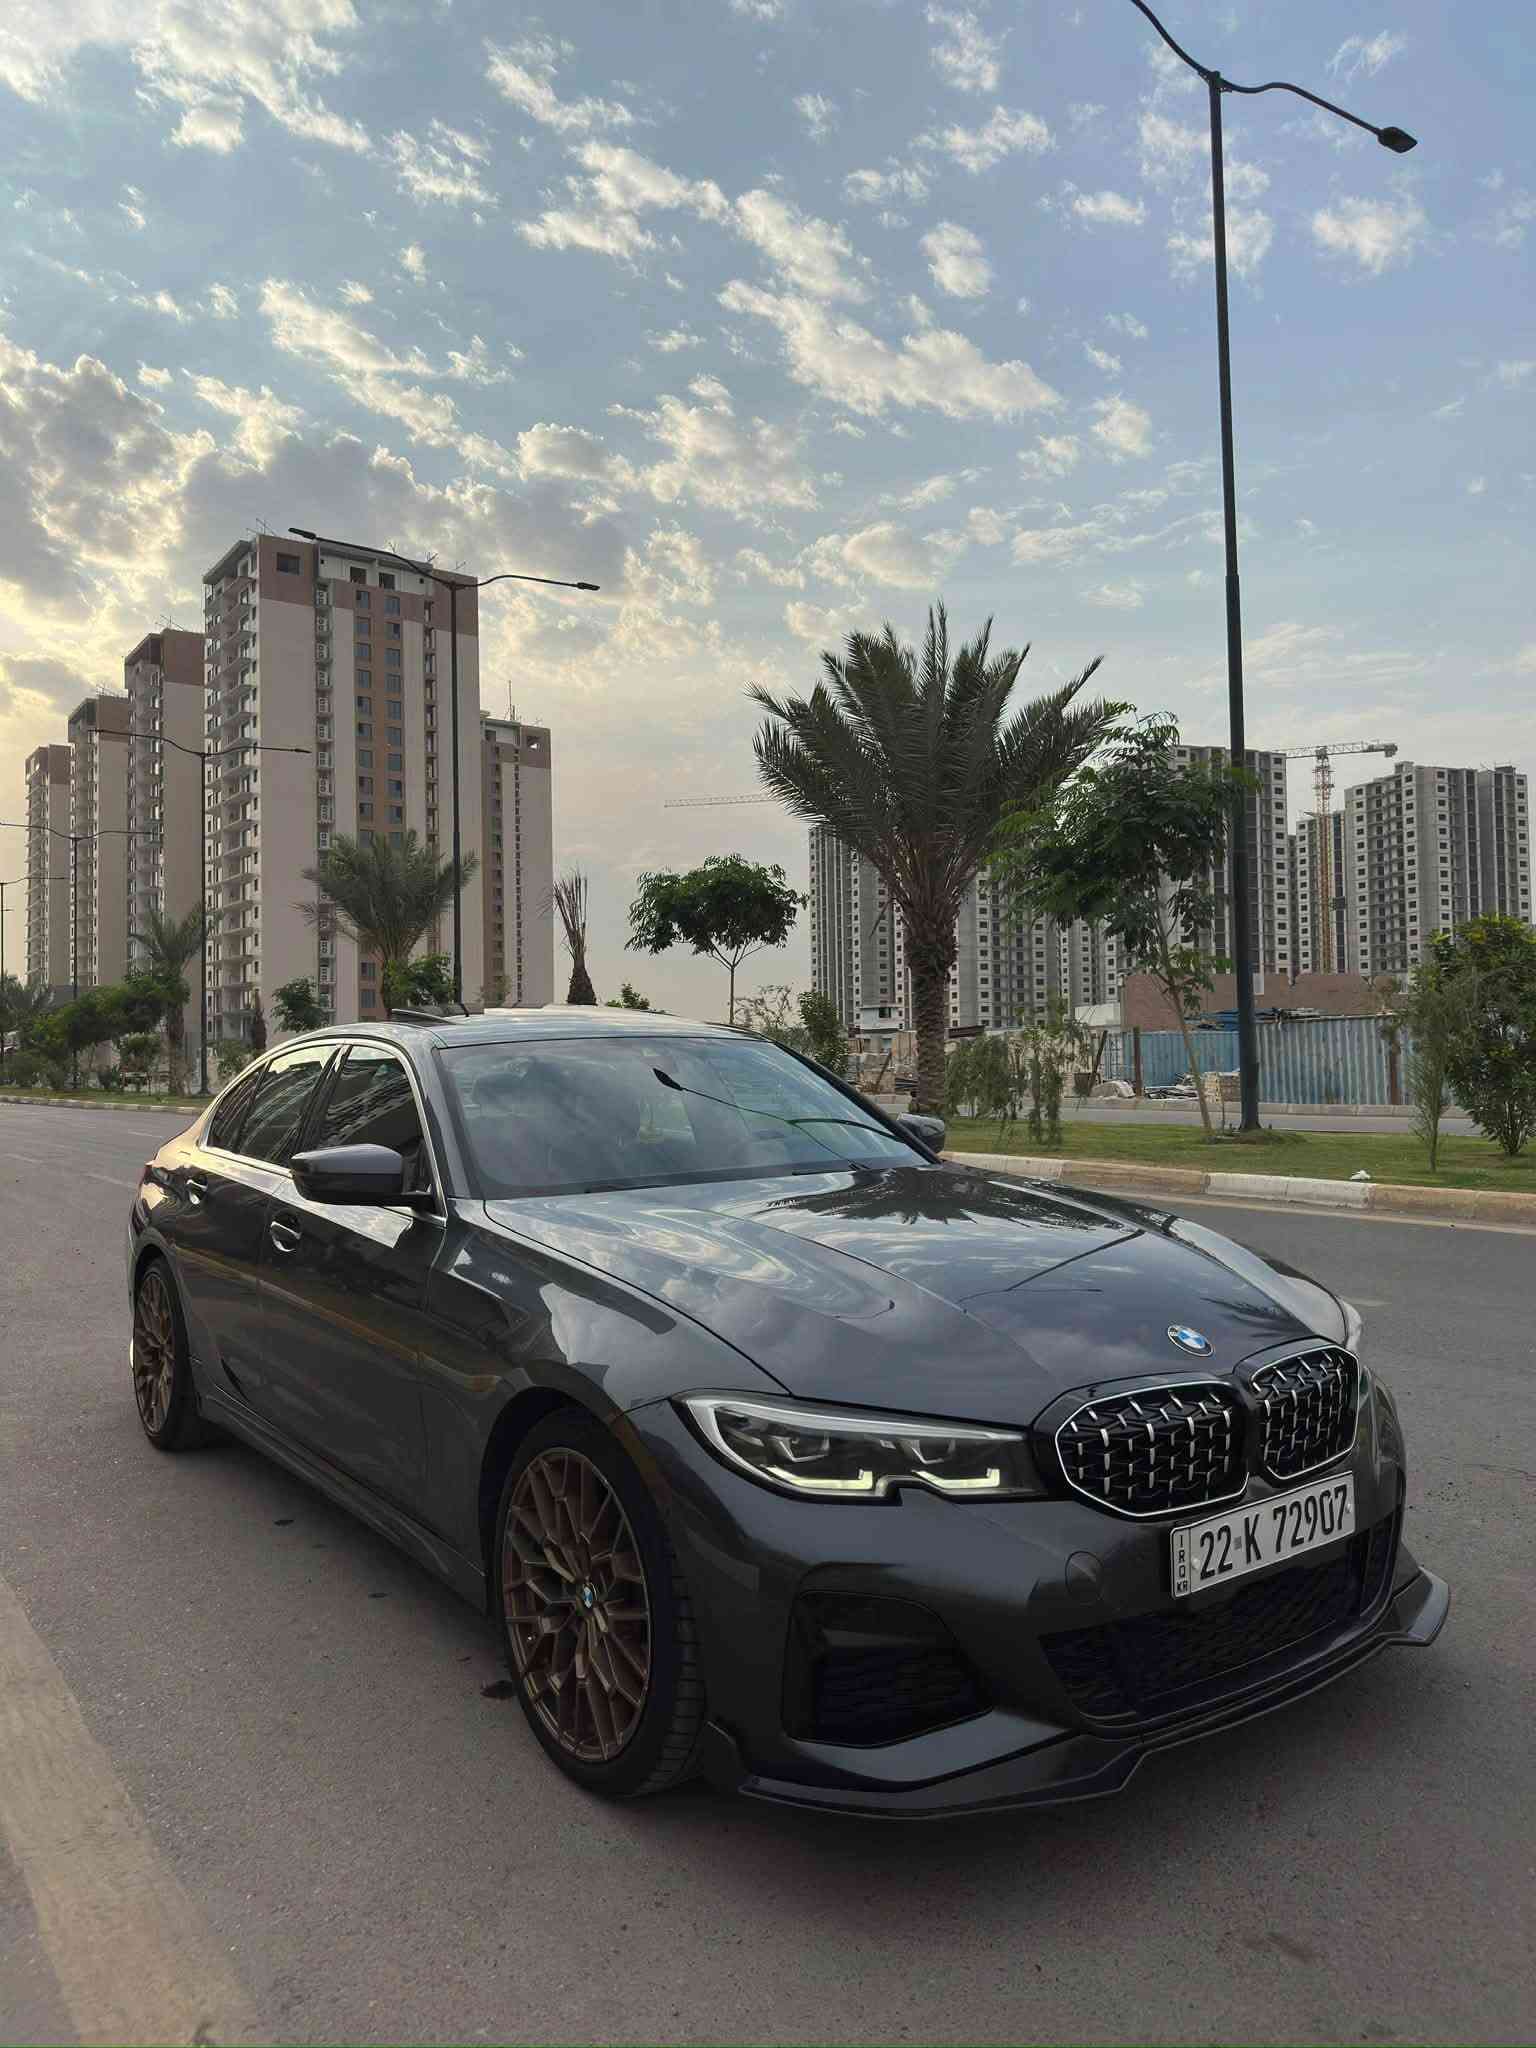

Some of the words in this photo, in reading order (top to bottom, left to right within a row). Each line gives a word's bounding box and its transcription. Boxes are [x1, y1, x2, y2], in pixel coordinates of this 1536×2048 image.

[1200, 1525, 1232, 1580] 22
[1244, 1513, 1262, 1564] K
[1273, 1484, 1348, 1553] 72907
